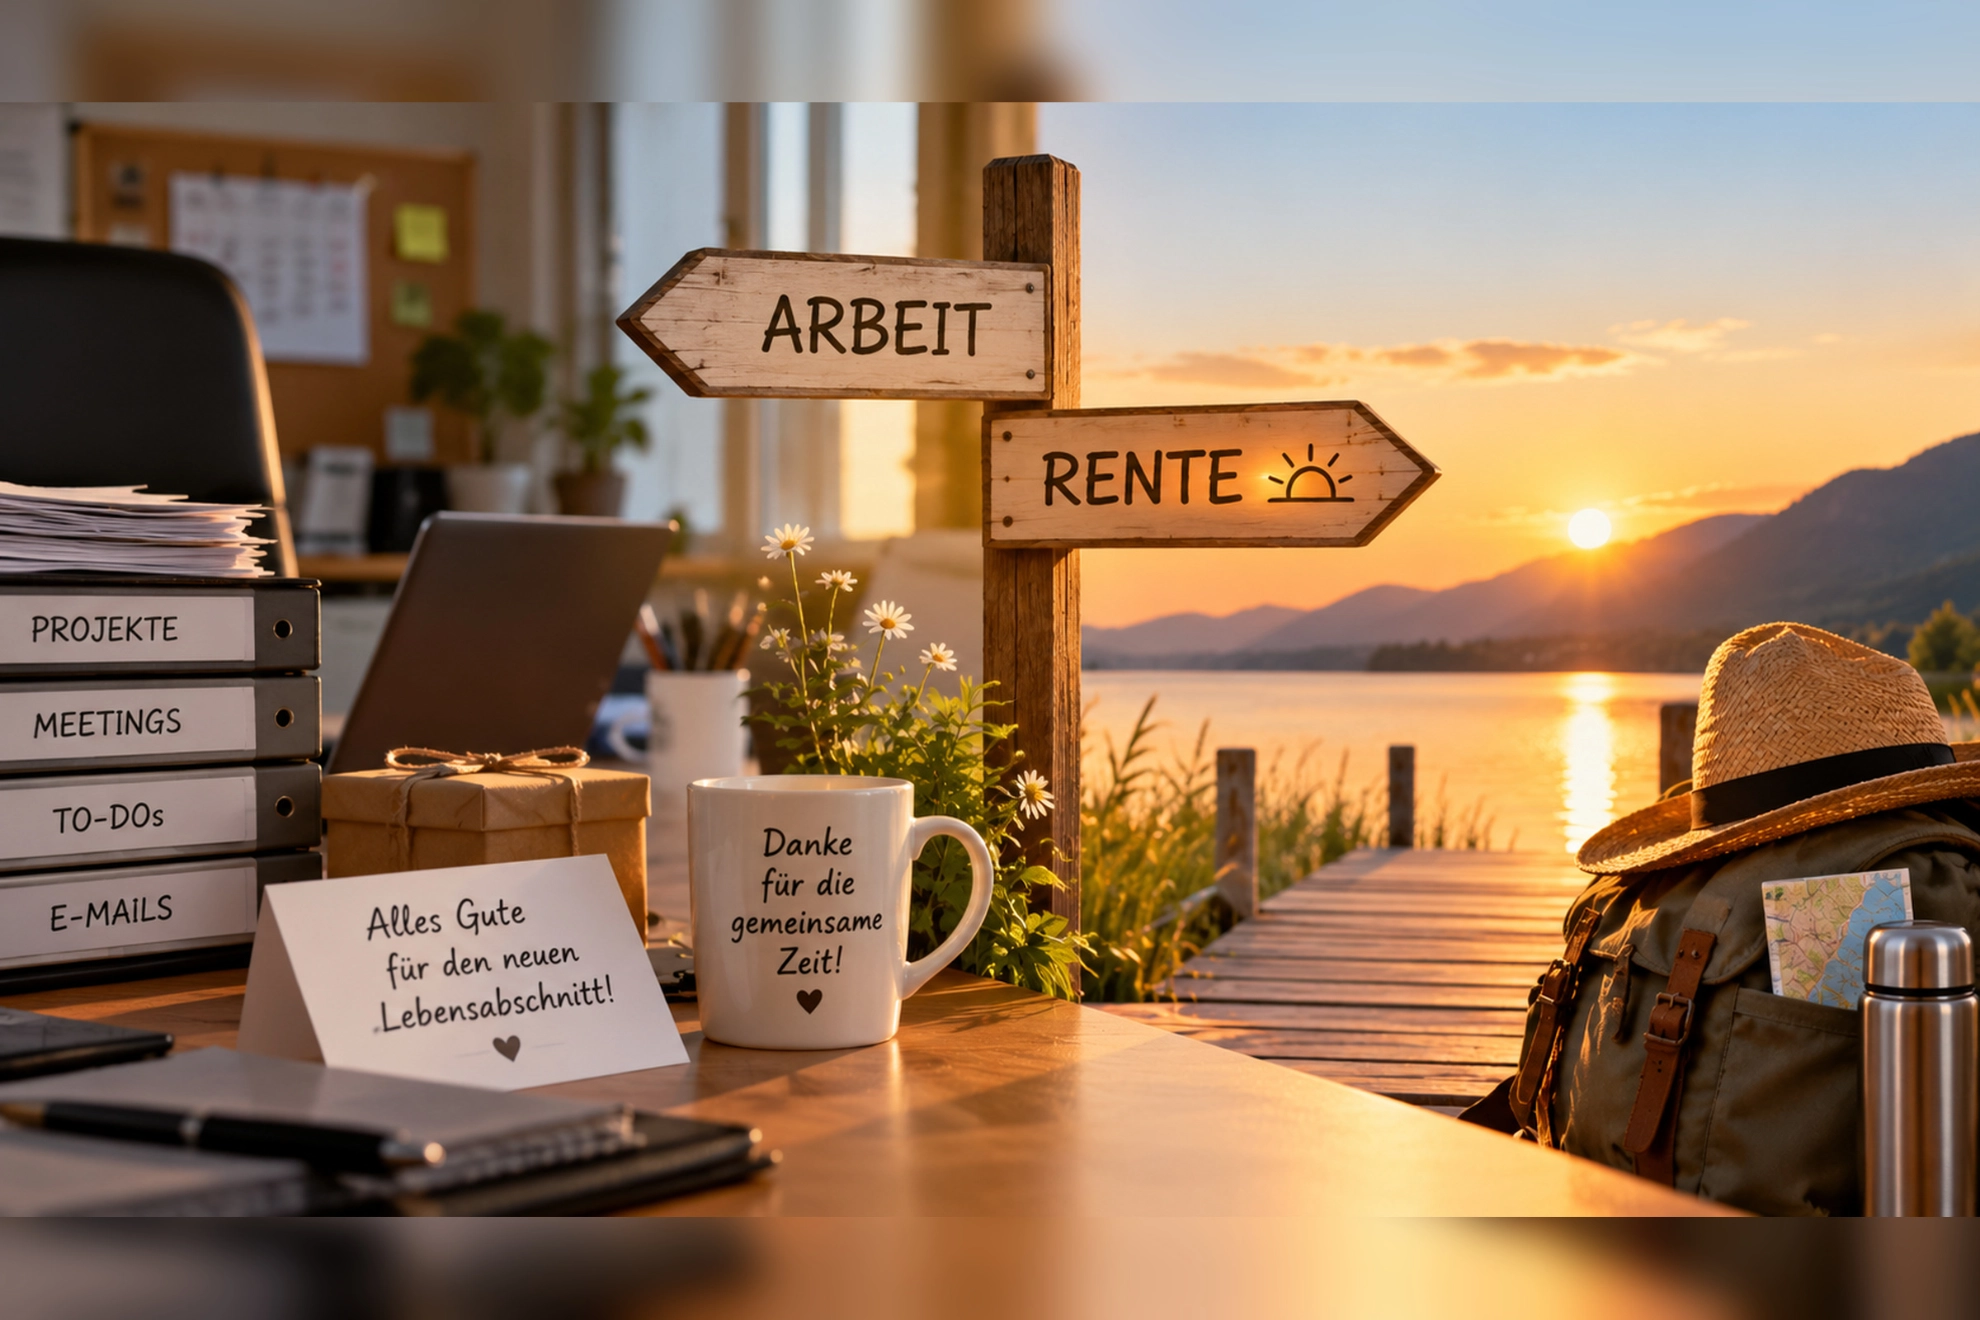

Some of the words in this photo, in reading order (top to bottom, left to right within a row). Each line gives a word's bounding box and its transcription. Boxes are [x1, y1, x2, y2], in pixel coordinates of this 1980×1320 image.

[761, 294, 992, 357] ARBEIT
[1042, 448, 1243, 507] RENTE
[31, 615, 178, 643] PROJEKTE
[33, 707, 182, 739] MEETINGS
[52, 802, 164, 834] TO-DOs
[763, 826, 853, 859] Danke
[761, 867, 806, 903] für
[816, 867, 856, 897] die
[50, 894, 173, 932] E-MAILS
[366, 904, 442, 942] Alles
[456, 897, 526, 934] Gute
[730, 910, 883, 944] gemeinsame
[386, 952, 431, 990] für
[442, 947, 493, 978] den
[503, 946, 580, 972] neuen
[776, 944, 843, 976] Zeit!
[380, 973, 615, 1033] Lebensabschnitt!
